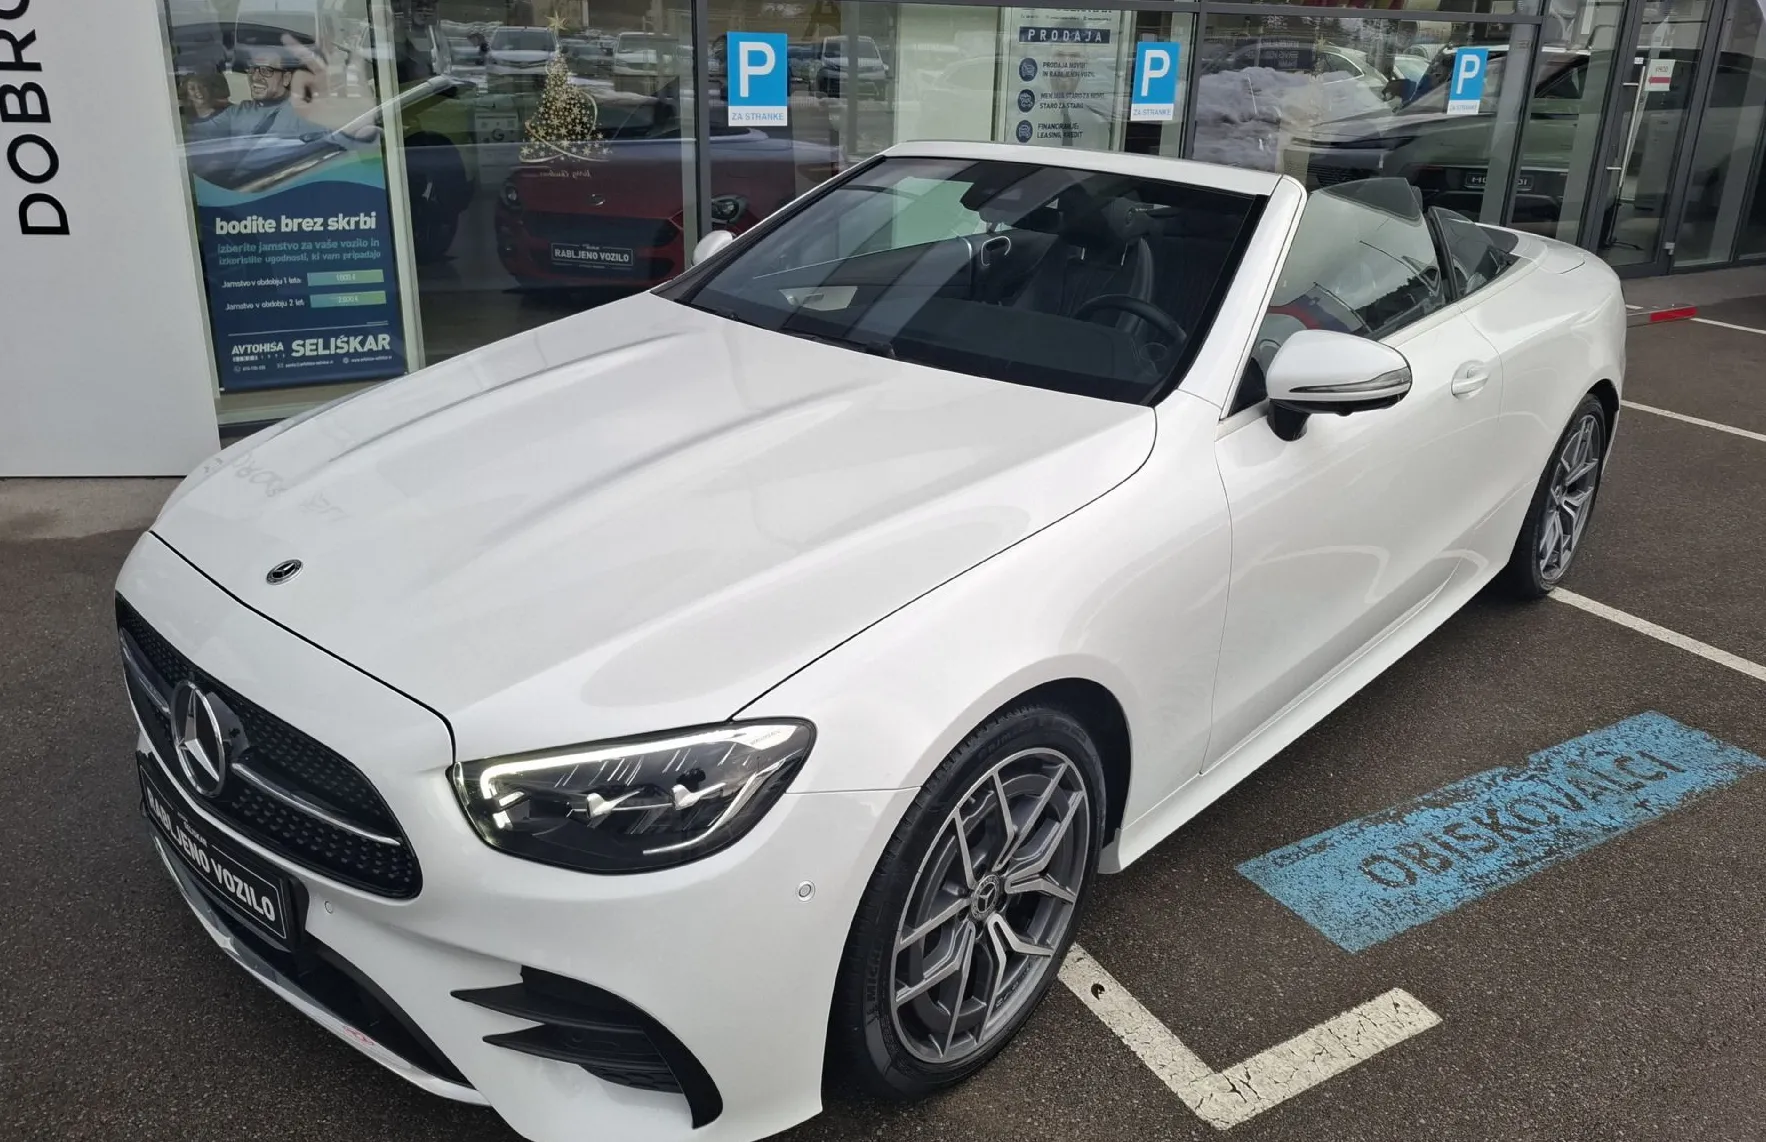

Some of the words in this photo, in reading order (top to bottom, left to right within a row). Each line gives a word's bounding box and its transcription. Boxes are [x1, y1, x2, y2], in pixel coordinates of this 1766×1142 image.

[1027, 29, 1102, 42] PRODAJA
[739, 41, 776, 97] P
[1141, 49, 1171, 97] P
[1456, 54, 1481, 94] P
[731, 113, 743, 121] ZA
[745, 112, 784, 121] STRANKE
[215, 215, 276, 235] bodite
[280, 214, 324, 232] brez
[327, 211, 377, 230] skrbi
[258, 241, 299, 254] jamstvo
[300, 241, 312, 250] za
[555, 249, 598, 260] RABLJENO
[600, 252, 629, 262] VOZILO
[291, 333, 390, 357] SELIŠKAR
[1360, 750, 1686, 888] OBISKOVALCI
[145, 785, 211, 876] RABLJENO
[210, 858, 276, 923] VOZILO
